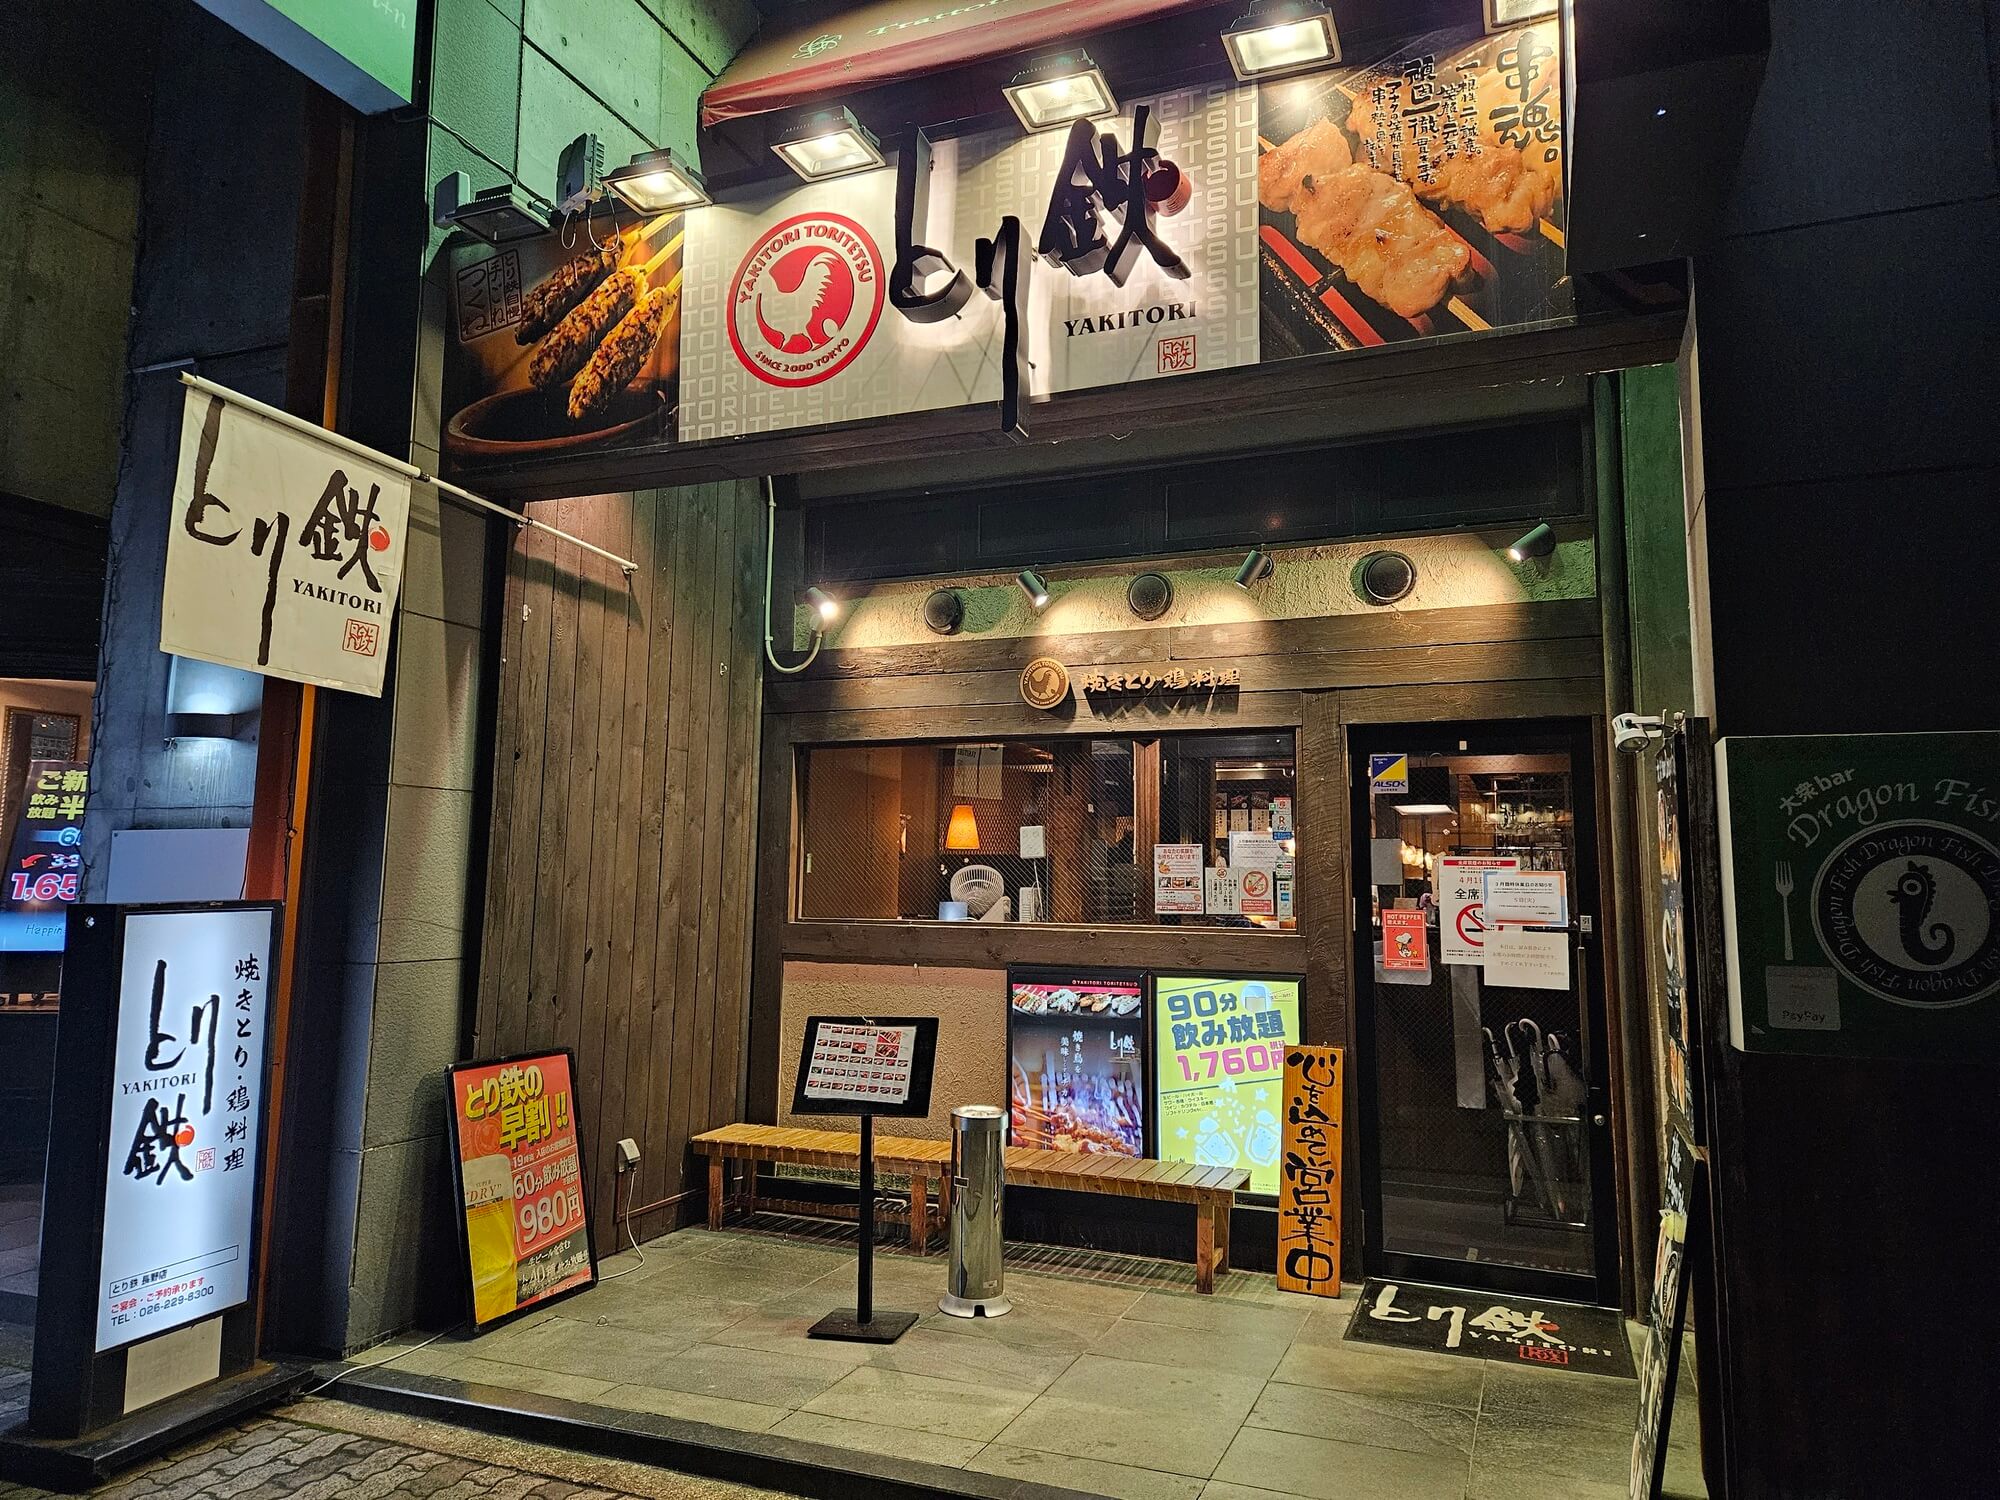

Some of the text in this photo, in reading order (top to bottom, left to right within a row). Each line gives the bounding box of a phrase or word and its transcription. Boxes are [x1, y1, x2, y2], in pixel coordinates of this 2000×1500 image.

[738, 225, 873, 304] YAKITORI TORITETSU
[889, 105, 1192, 443] とり鉄
[459, 268, 491, 335] つくね
[1064, 301, 1197, 338] YAKITORI
[755, 337, 850, 373] SINCE 2000 TOKYO
[185, 396, 382, 666] とり鉄
[292, 578, 382, 615] YAKITORI
[30, 793, 60, 806] 飲み
[1373, 780, 1406, 788] ALSOK
[26, 807, 56, 819] 放題
[1787, 781, 1921, 848] Dragon
[1860, 834, 1983, 867] Dragon Fish
[1454, 887, 1483, 901] 全席
[1386, 913, 1422, 921] HOT PEPPER
[1167, 990, 1237, 1022] 90分
[1782, 1009, 1826, 1024] PayPay
[1172, 1010, 1286, 1051] 飲み放題
[223, 953, 261, 1173] 焼きとり・鶏料理
[1072, 1030, 1084, 1074] 焼き鳥を
[1176, 1045, 1284, 1083] 1,760円
[122, 1072, 197, 1096] YAKITORI
[465, 1065, 544, 1121] とり鉄の
[500, 1091, 569, 1150] 早割!!
[513, 1153, 578, 1200] 60分飲み放題
[520, 1189, 582, 1243] 980円
[110, 1277, 205, 1314] ご宴会・ご予約承ります
[112, 1268, 168, 1294] とり鉄 長野店
[1370, 1285, 1566, 1348] とり鉄
[1469, 1330, 1612, 1357] YAKITORI
